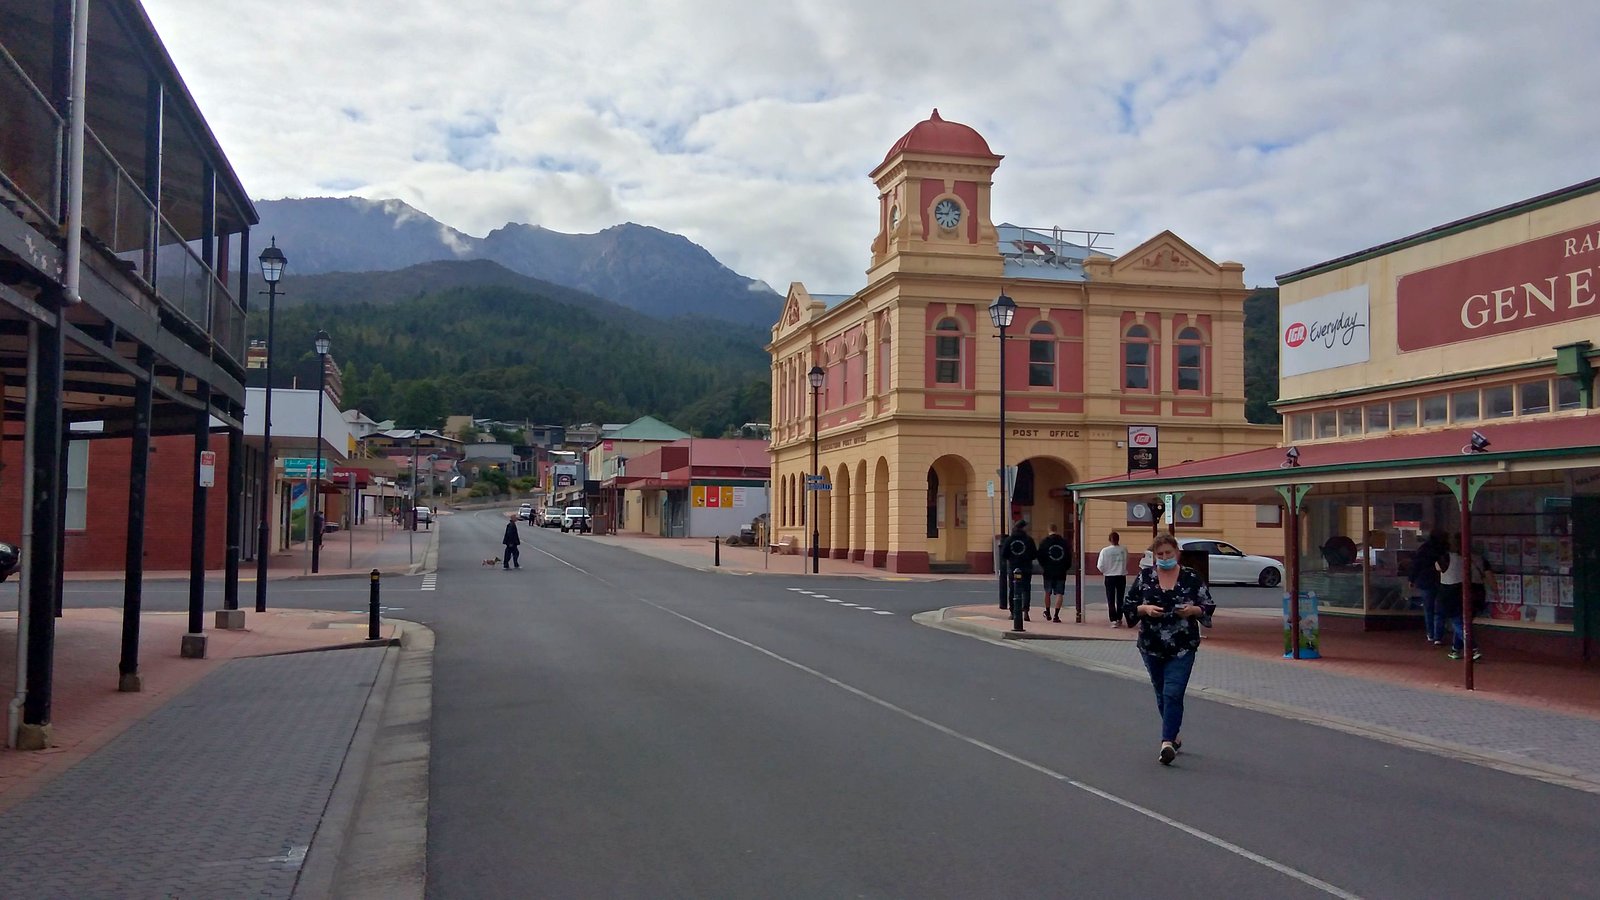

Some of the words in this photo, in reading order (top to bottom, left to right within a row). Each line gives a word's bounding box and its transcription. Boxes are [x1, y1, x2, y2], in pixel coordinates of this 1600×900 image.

[1461, 267, 1600, 330] GENE
[1287, 325, 1305, 343] IGA
[1310, 312, 1366, 349] Everyday
[1012, 429, 1040, 438] POST
[1049, 430, 1080, 439] OFFICE
